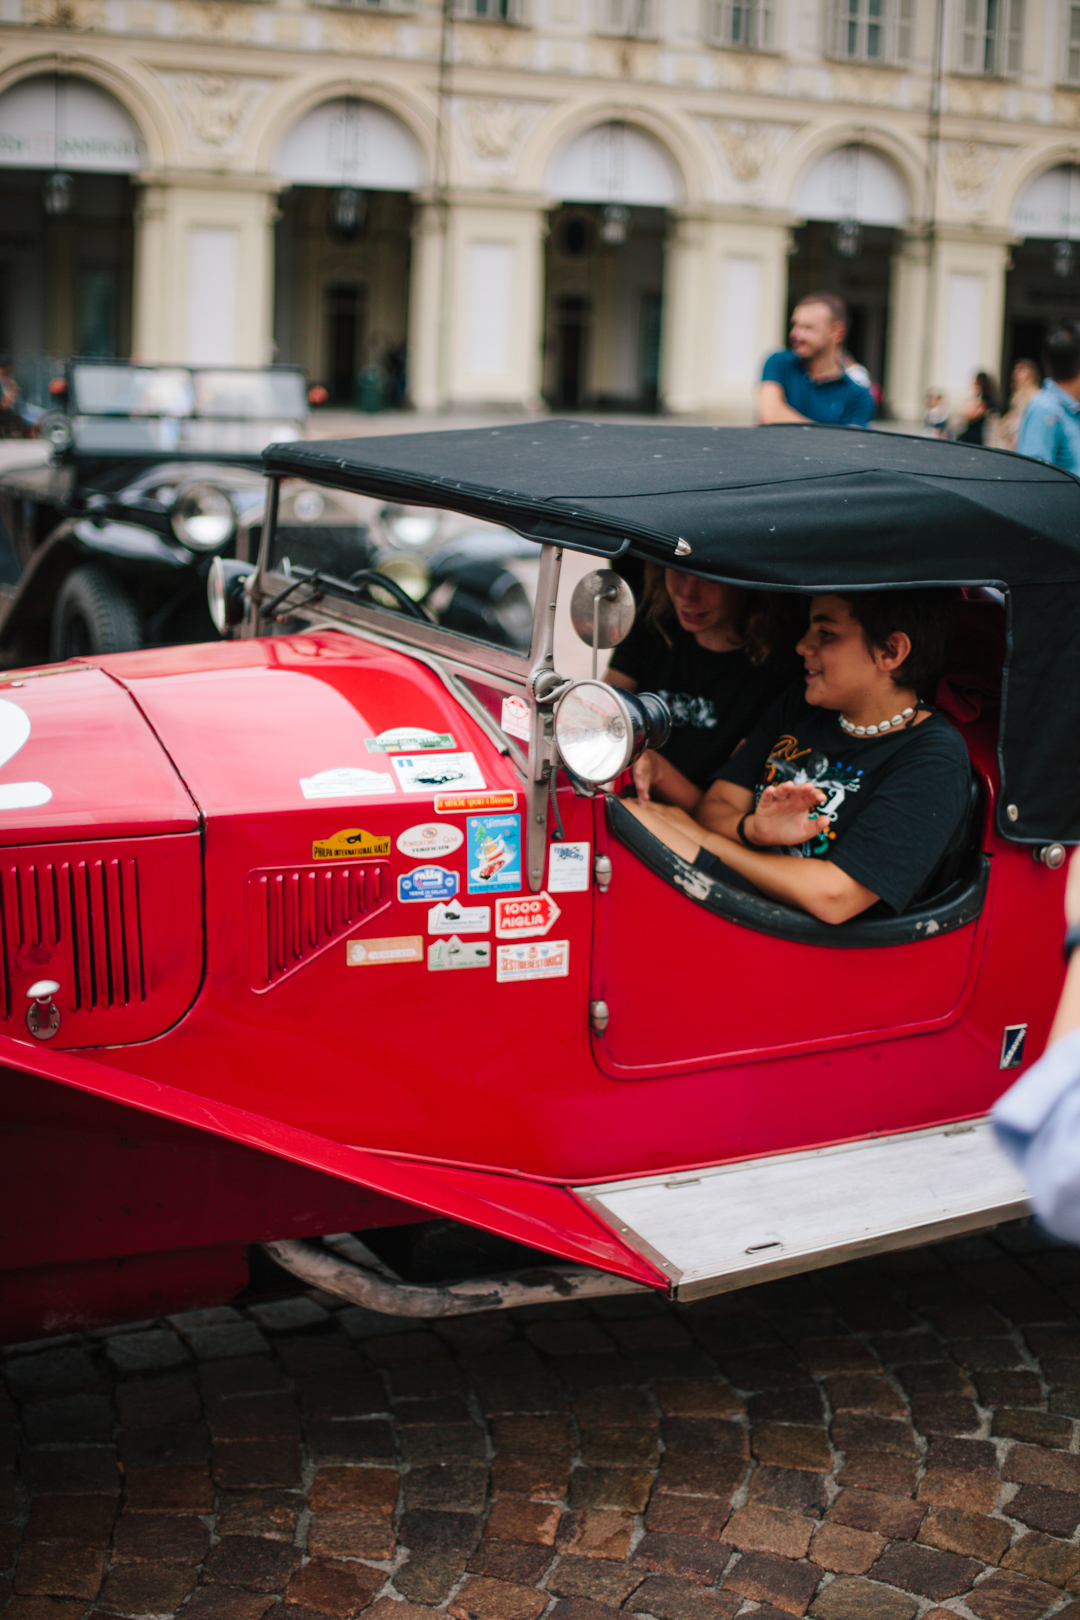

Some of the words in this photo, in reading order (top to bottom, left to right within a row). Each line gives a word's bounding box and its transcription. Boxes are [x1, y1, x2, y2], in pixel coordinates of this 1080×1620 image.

[314, 846, 333, 858] PHILPA
[334, 846, 373, 856] INTERNATIONAL
[374, 841, 388, 854] RALLY
[412, 844, 450, 853] VERIFICATO
[413, 869, 443, 886] rally
[469, 883, 510, 892] VERIFICATO
[504, 901, 541, 915] 1000
[501, 914, 544, 928] MIGLIA
